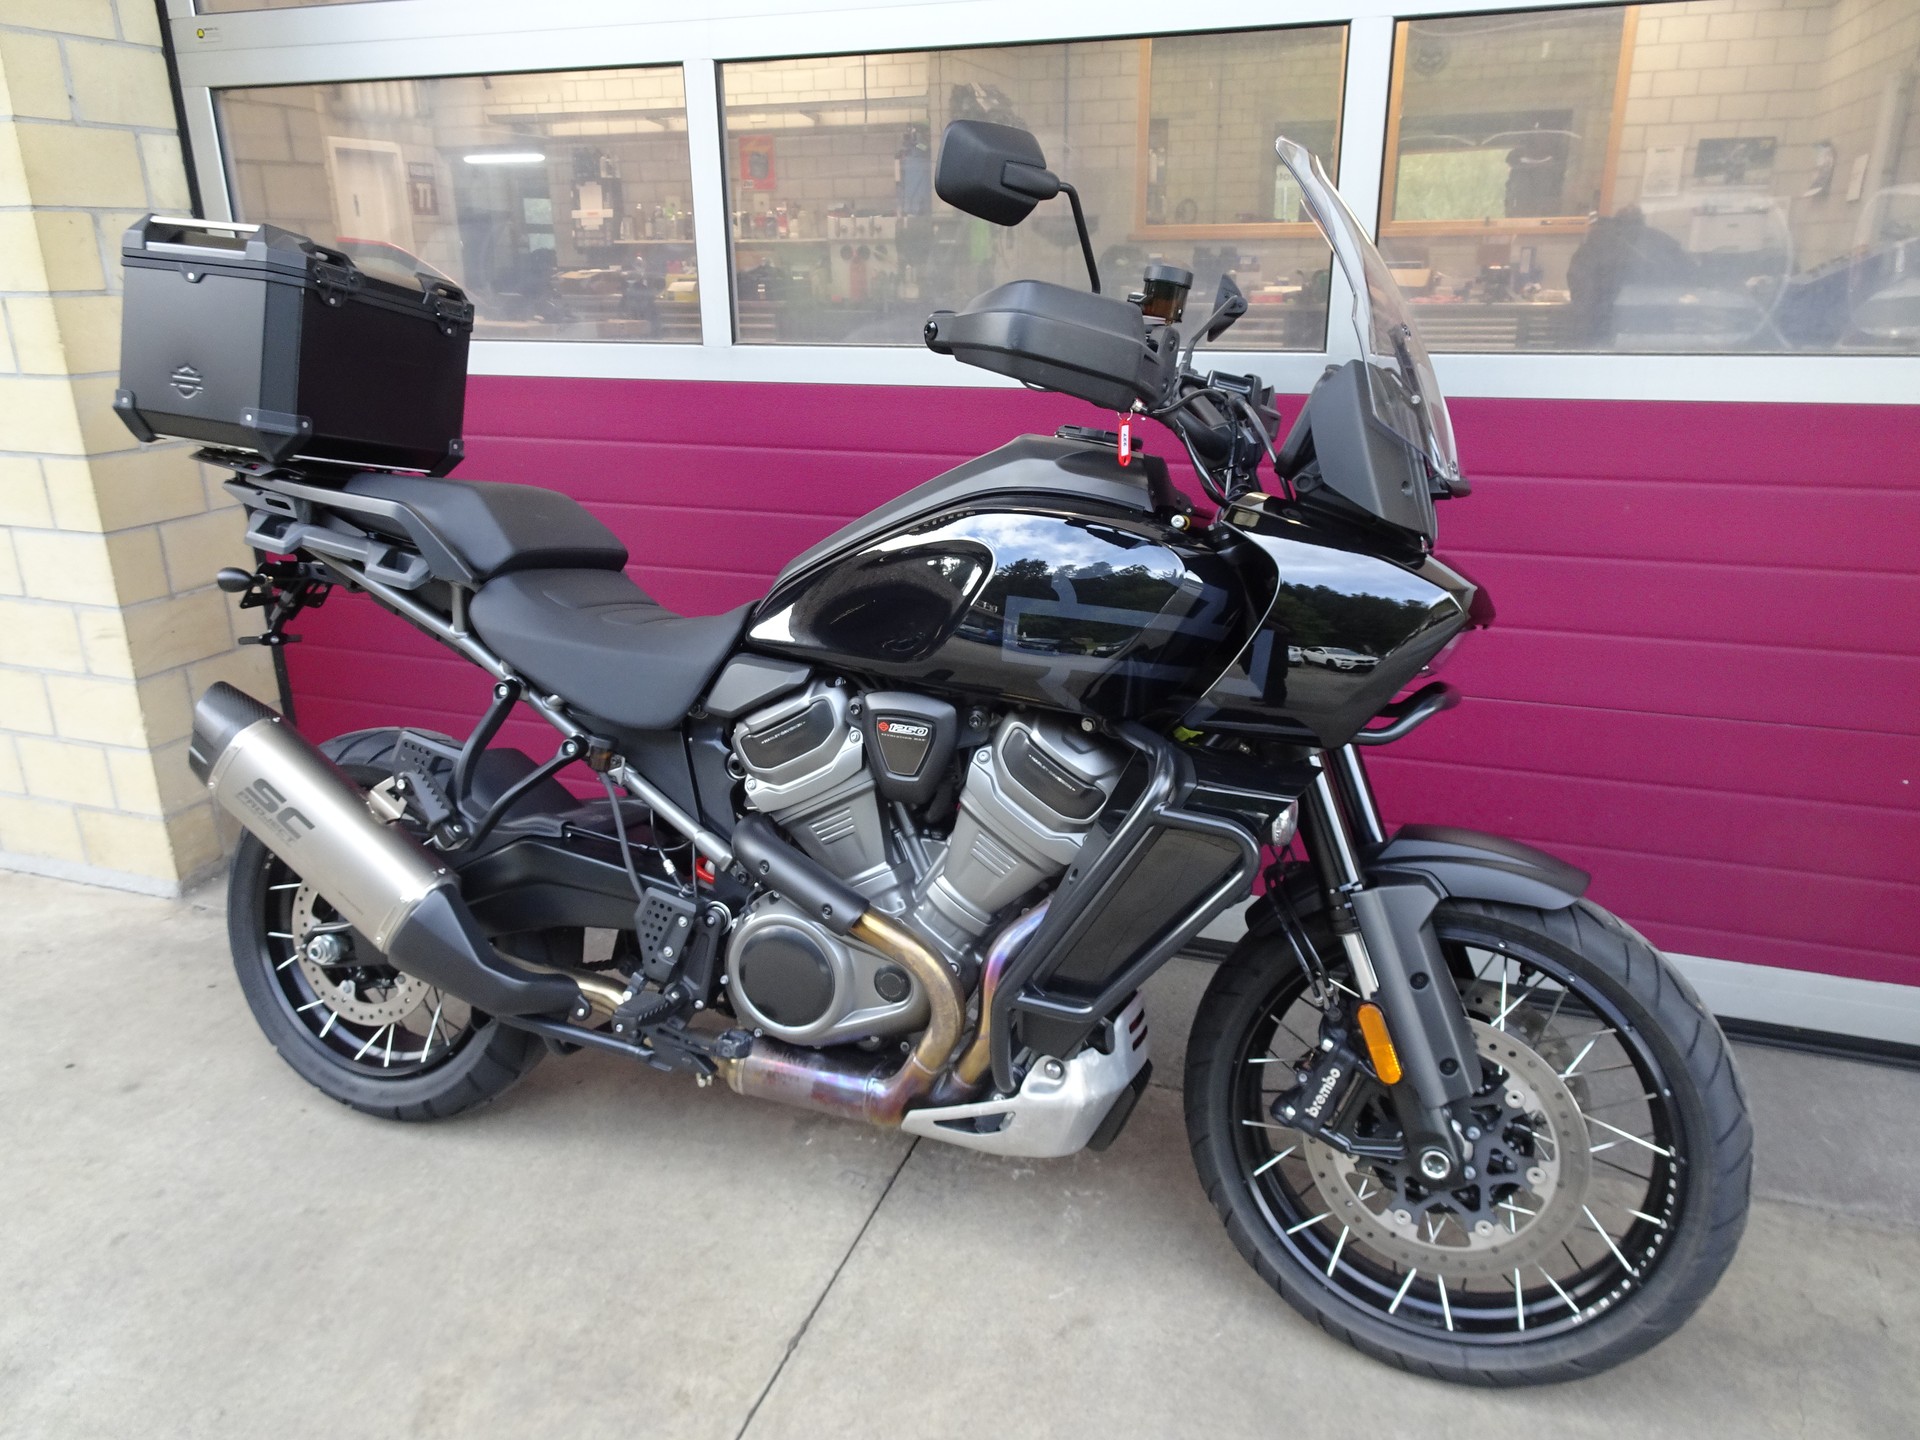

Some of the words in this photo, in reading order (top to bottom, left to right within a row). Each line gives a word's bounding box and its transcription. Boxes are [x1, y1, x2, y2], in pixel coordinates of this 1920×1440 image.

[889, 723, 929, 737] 1250
[244, 778, 316, 840] SC
[1304, 1067, 1341, 1118] brembo
